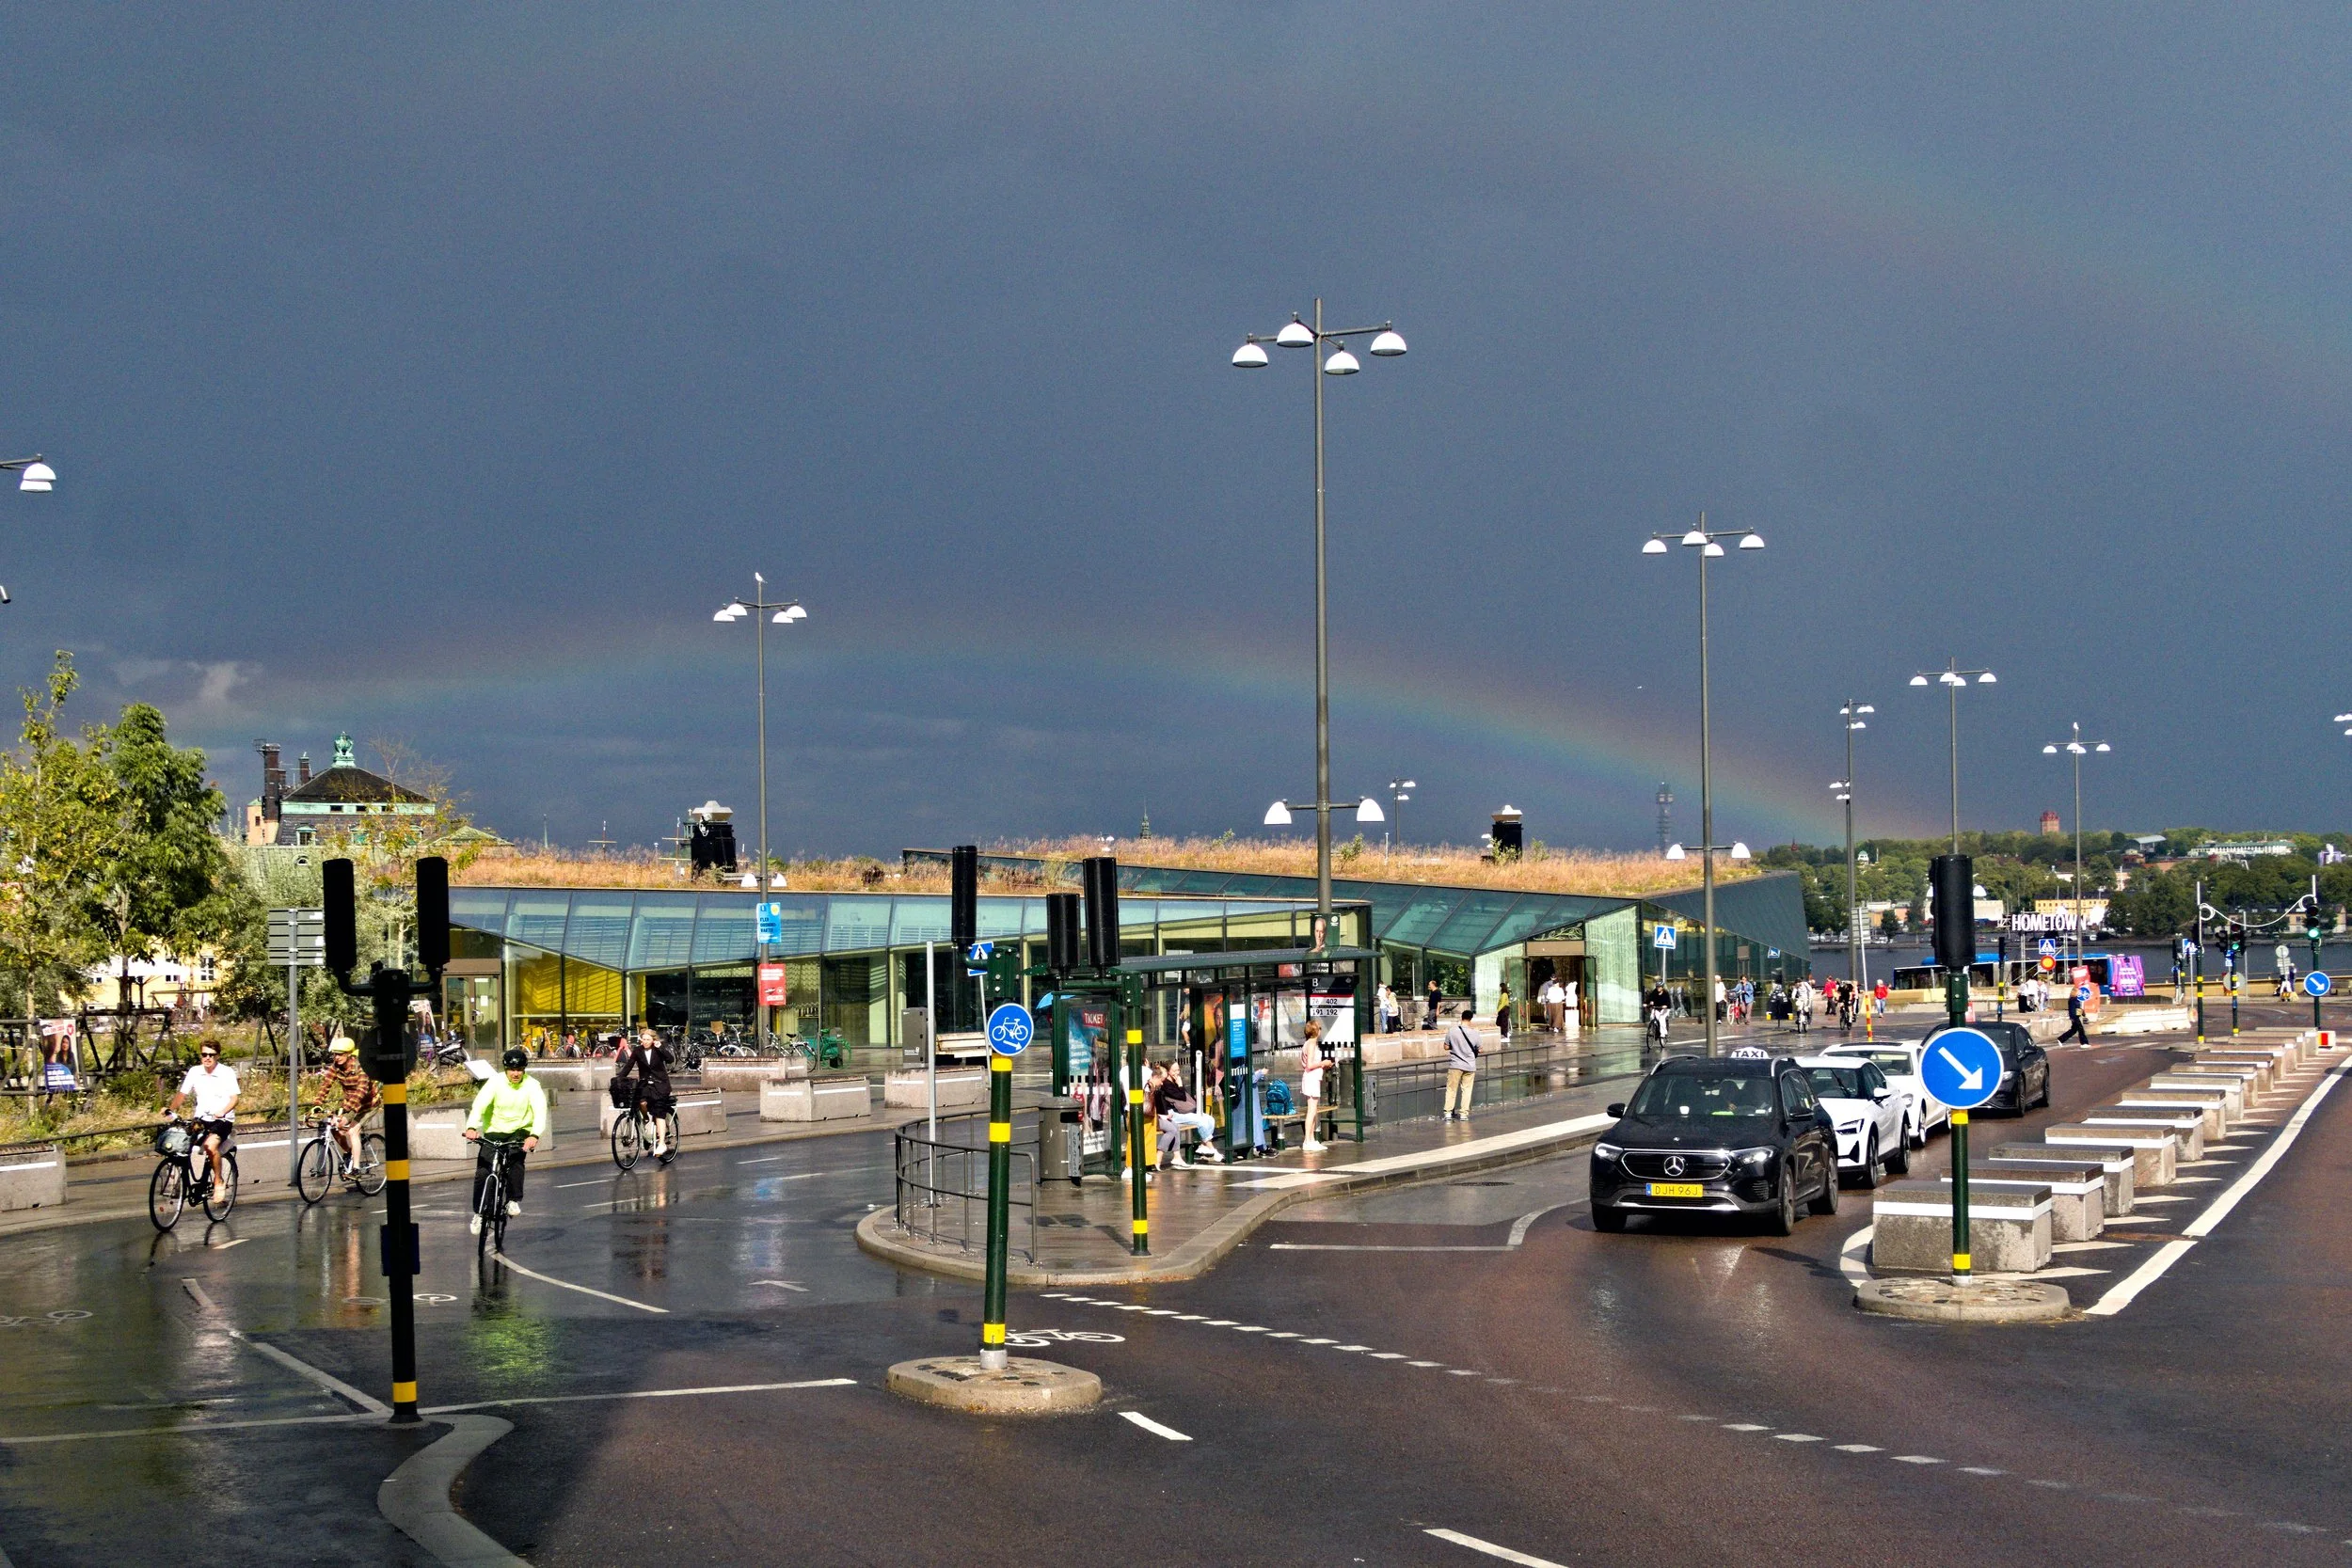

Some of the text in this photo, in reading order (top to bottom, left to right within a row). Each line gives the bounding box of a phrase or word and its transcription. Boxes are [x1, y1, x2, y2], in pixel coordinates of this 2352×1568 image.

[2012, 914, 2086, 930] HOMETOWN
[1312, 978, 1319, 987] B
[1084, 1012, 1104, 1024] TICKET
[1656, 1186, 1698, 1196] DJH 96J
